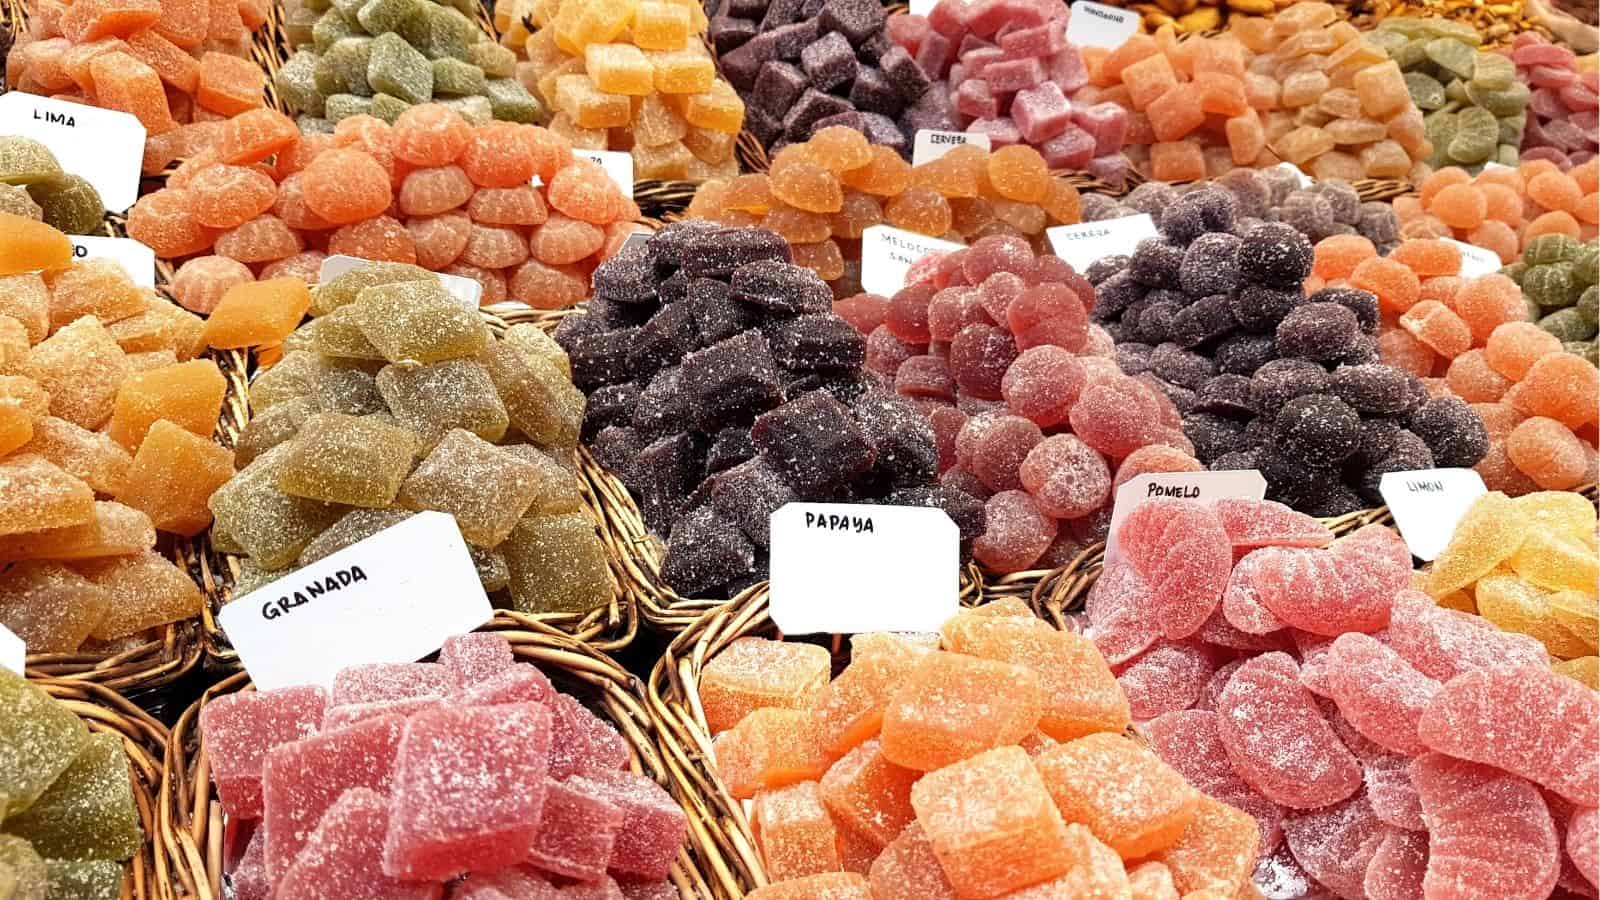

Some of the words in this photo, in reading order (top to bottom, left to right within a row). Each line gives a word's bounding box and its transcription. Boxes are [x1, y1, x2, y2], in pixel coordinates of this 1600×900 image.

[33, 108, 76, 129] LIMA
[1147, 482, 1200, 498] POMELO
[1406, 480, 1444, 493] LIMON
[805, 511, 874, 534] PAPAYA
[262, 565, 367, 620] GRANADA
